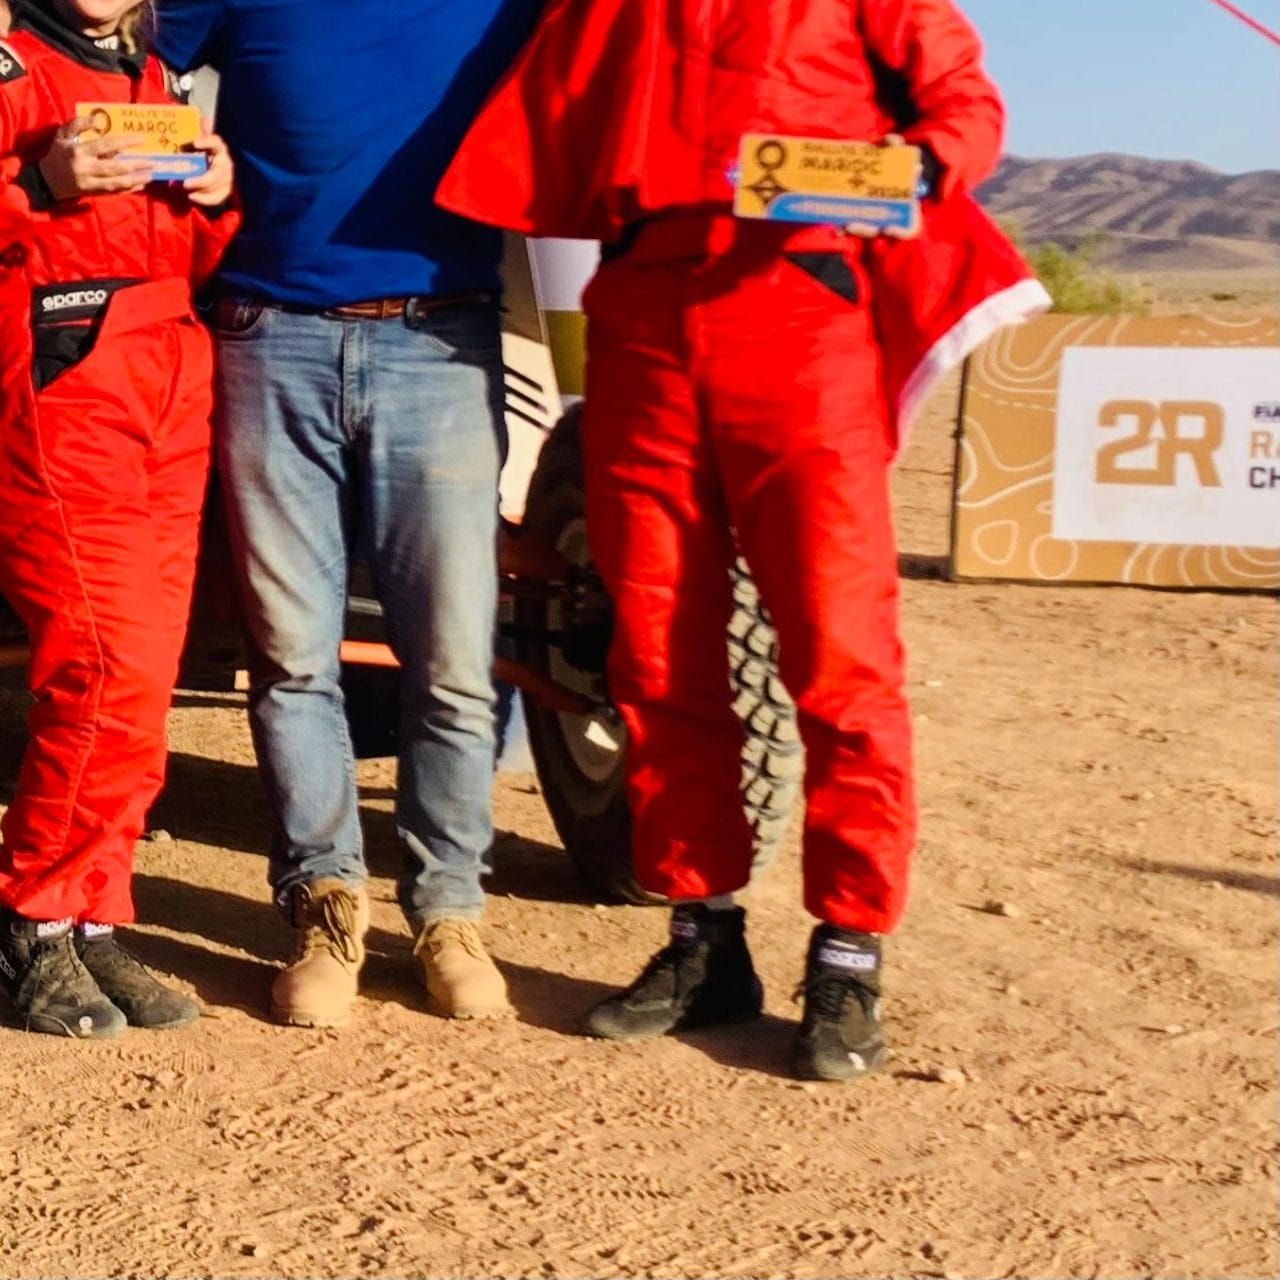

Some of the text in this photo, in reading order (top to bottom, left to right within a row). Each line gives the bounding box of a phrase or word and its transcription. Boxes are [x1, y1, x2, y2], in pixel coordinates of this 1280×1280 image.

[122, 121, 178, 134] MAROC
[1095, 399, 1225, 487] 2R
[1250, 431, 1280, 458] R
